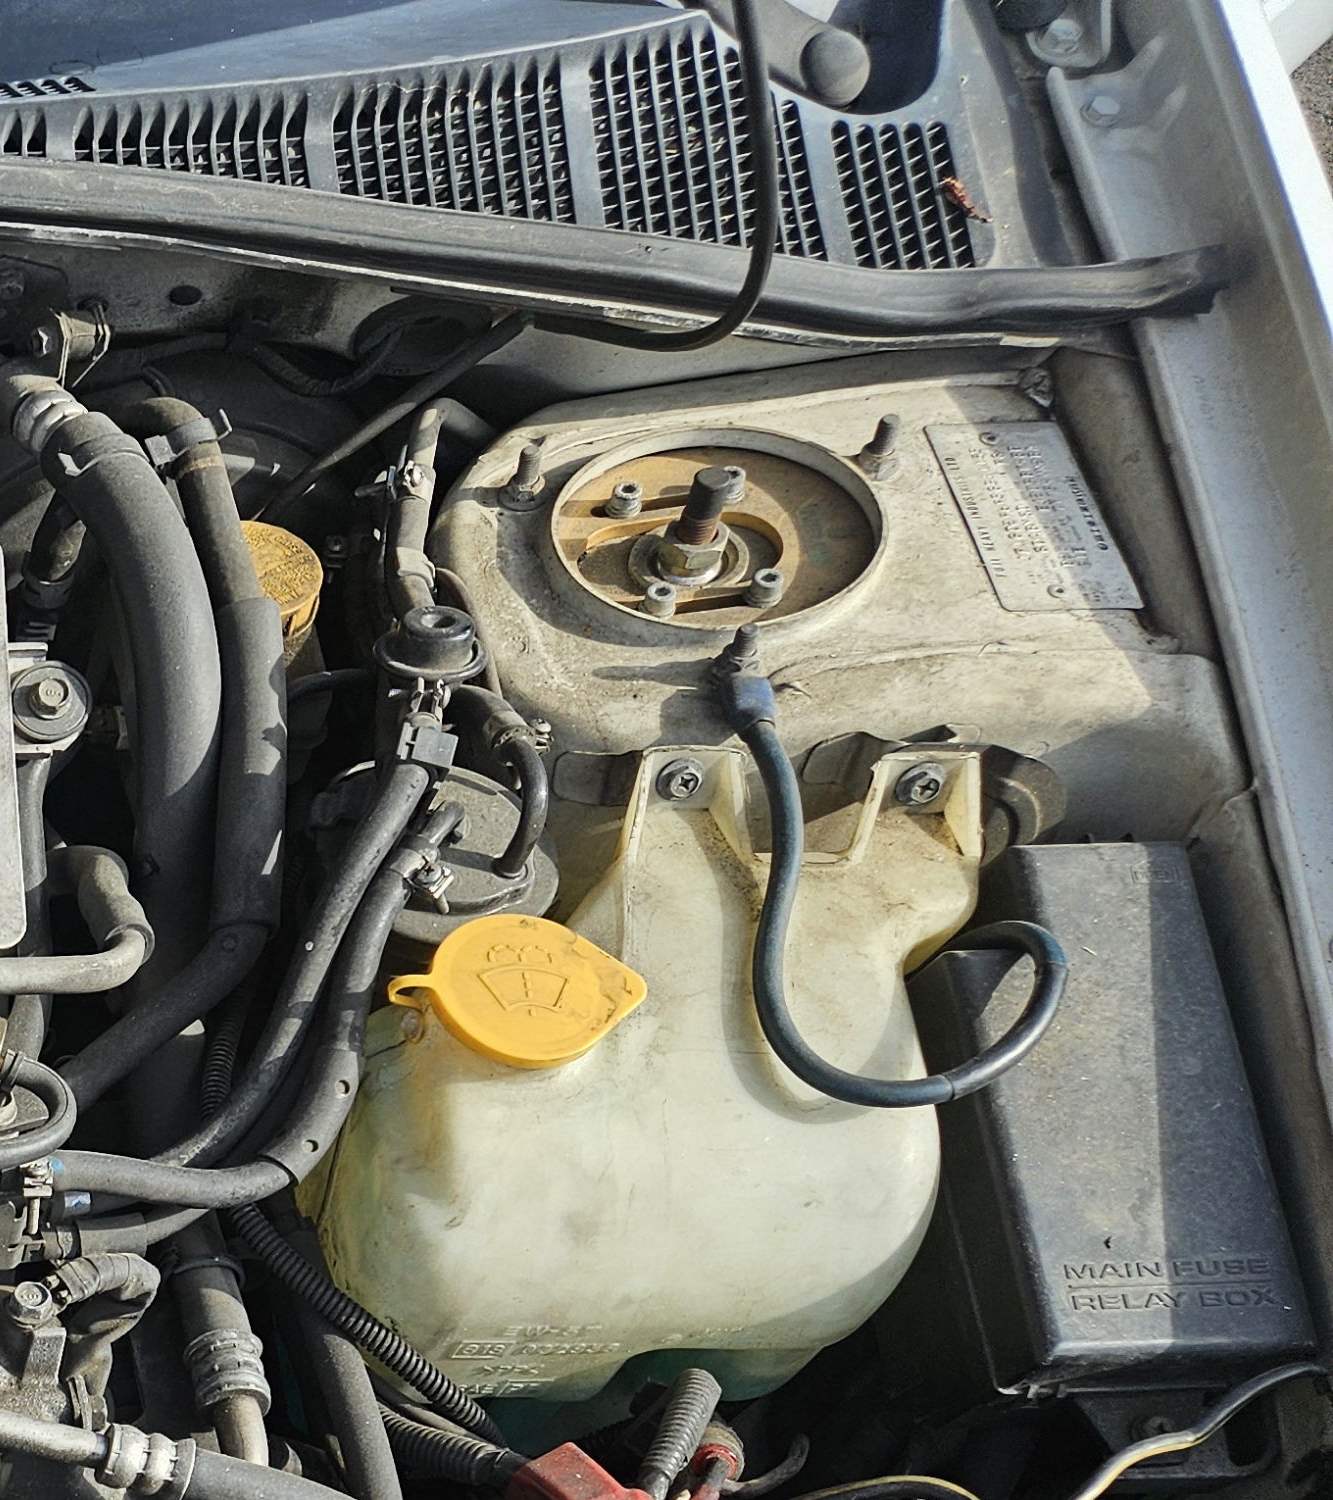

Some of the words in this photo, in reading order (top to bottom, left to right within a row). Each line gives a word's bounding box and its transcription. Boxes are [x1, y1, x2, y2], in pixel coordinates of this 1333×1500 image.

[1064, 1260, 1165, 1280] MAIN
[1173, 1258, 1270, 1277] FUSE
[1071, 1291, 1186, 1311] RELAY
[1199, 1288, 1278, 1308] BOX
